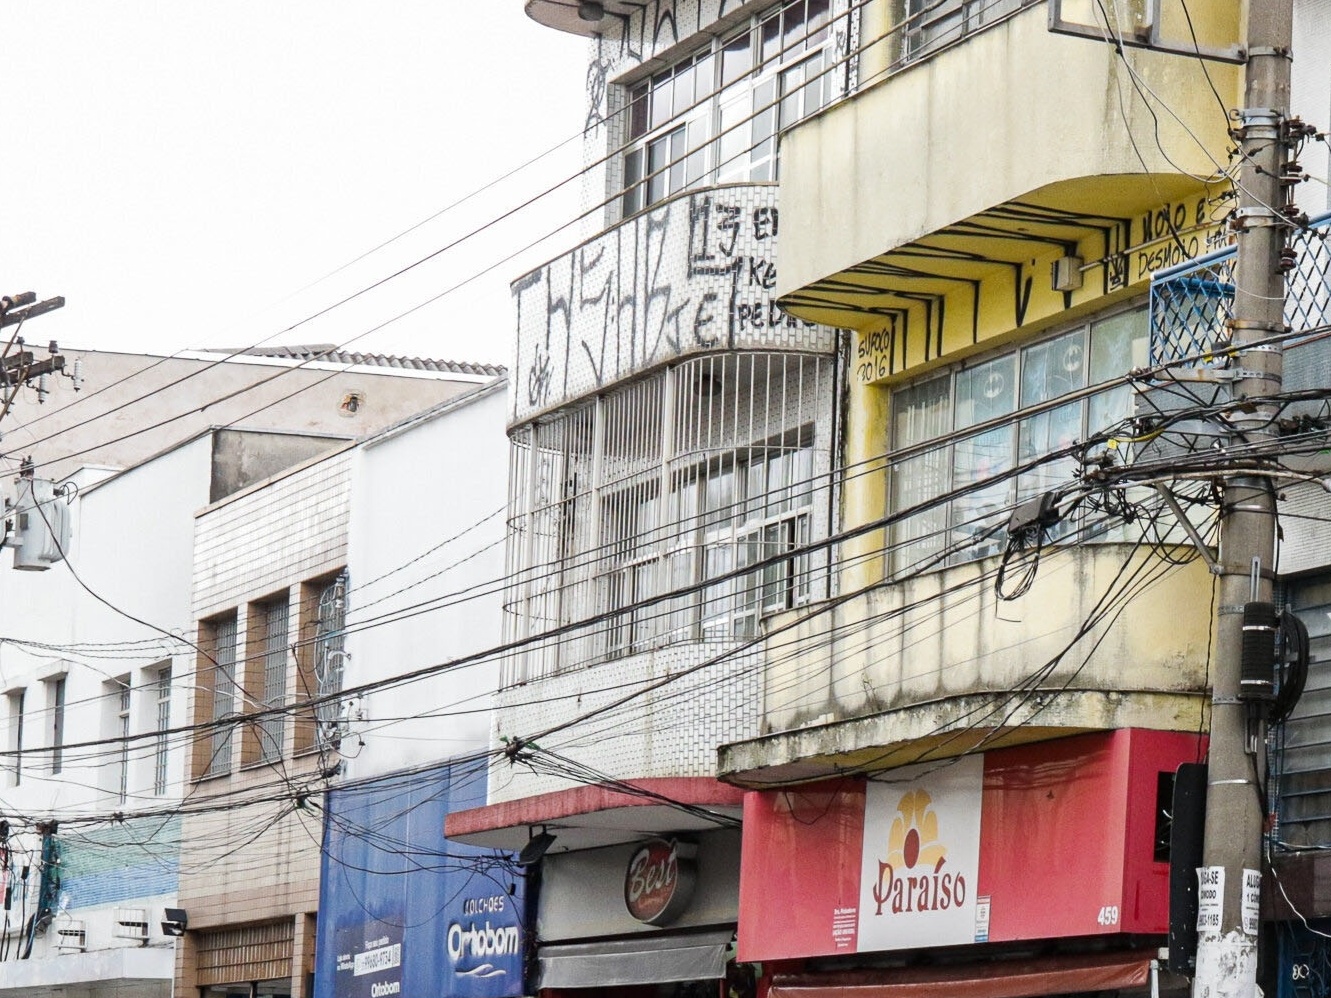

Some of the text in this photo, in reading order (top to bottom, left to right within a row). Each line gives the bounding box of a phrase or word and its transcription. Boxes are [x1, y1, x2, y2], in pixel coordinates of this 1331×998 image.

[873, 856, 966, 916] Paraíso
[1097, 905, 1119, 926] 459
[447, 920, 519, 961] Ortobom
[371, 980, 400, 998] Ortobom
